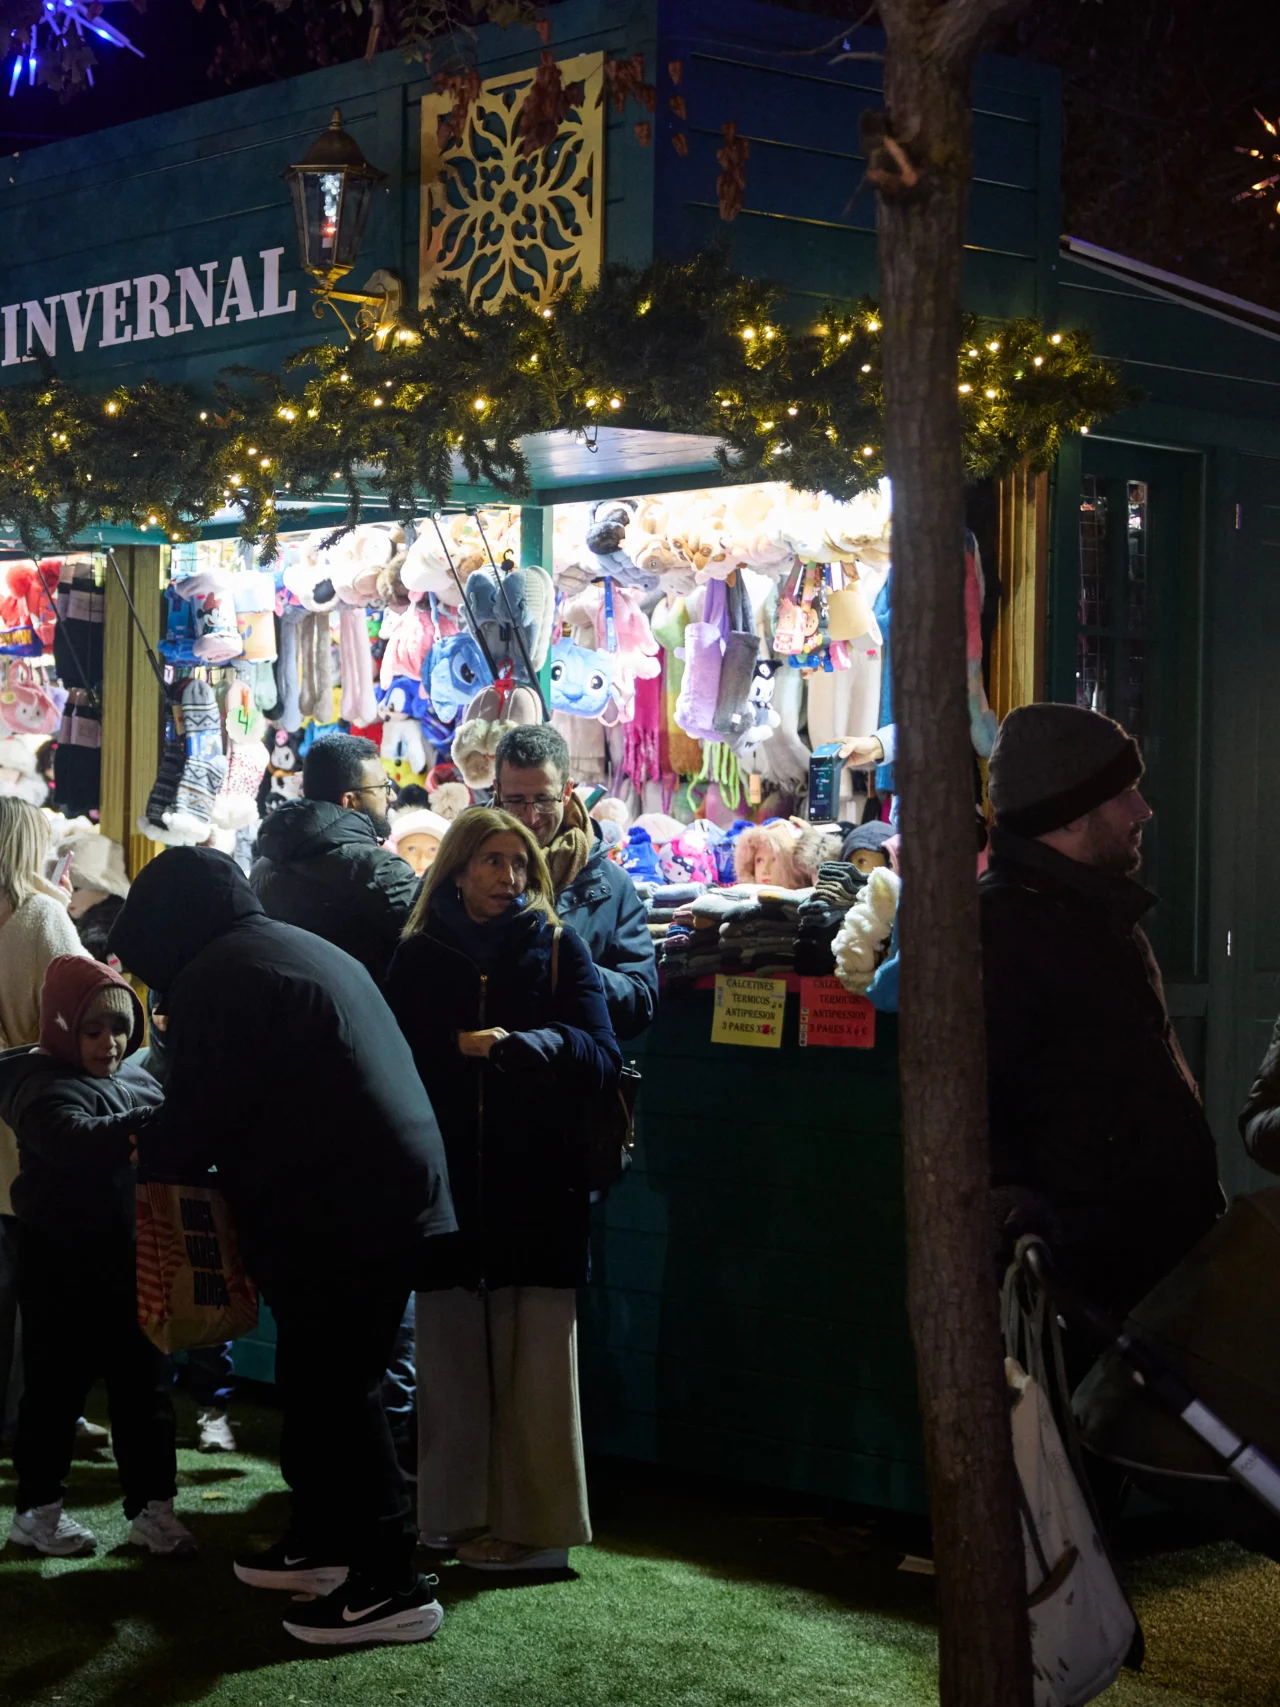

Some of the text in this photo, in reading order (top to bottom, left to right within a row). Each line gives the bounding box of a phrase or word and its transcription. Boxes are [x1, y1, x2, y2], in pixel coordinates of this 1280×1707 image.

[1, 247, 297, 367] INVERNAL
[726, 978, 774, 991] CALCETINES
[732, 993, 770, 1006] TERMICOS
[820, 995, 860, 1005] TERMICOS
[725, 1007, 776, 1021] ANTIPRESION
[812, 1009, 866, 1022] ANTIPRESION
[721, 1021, 727, 1030] 3
[728, 1022, 755, 1033] PARES
[756, 1024, 762, 1034] X
[809, 1023, 815, 1033] 3
[816, 1024, 845, 1034] PARES
